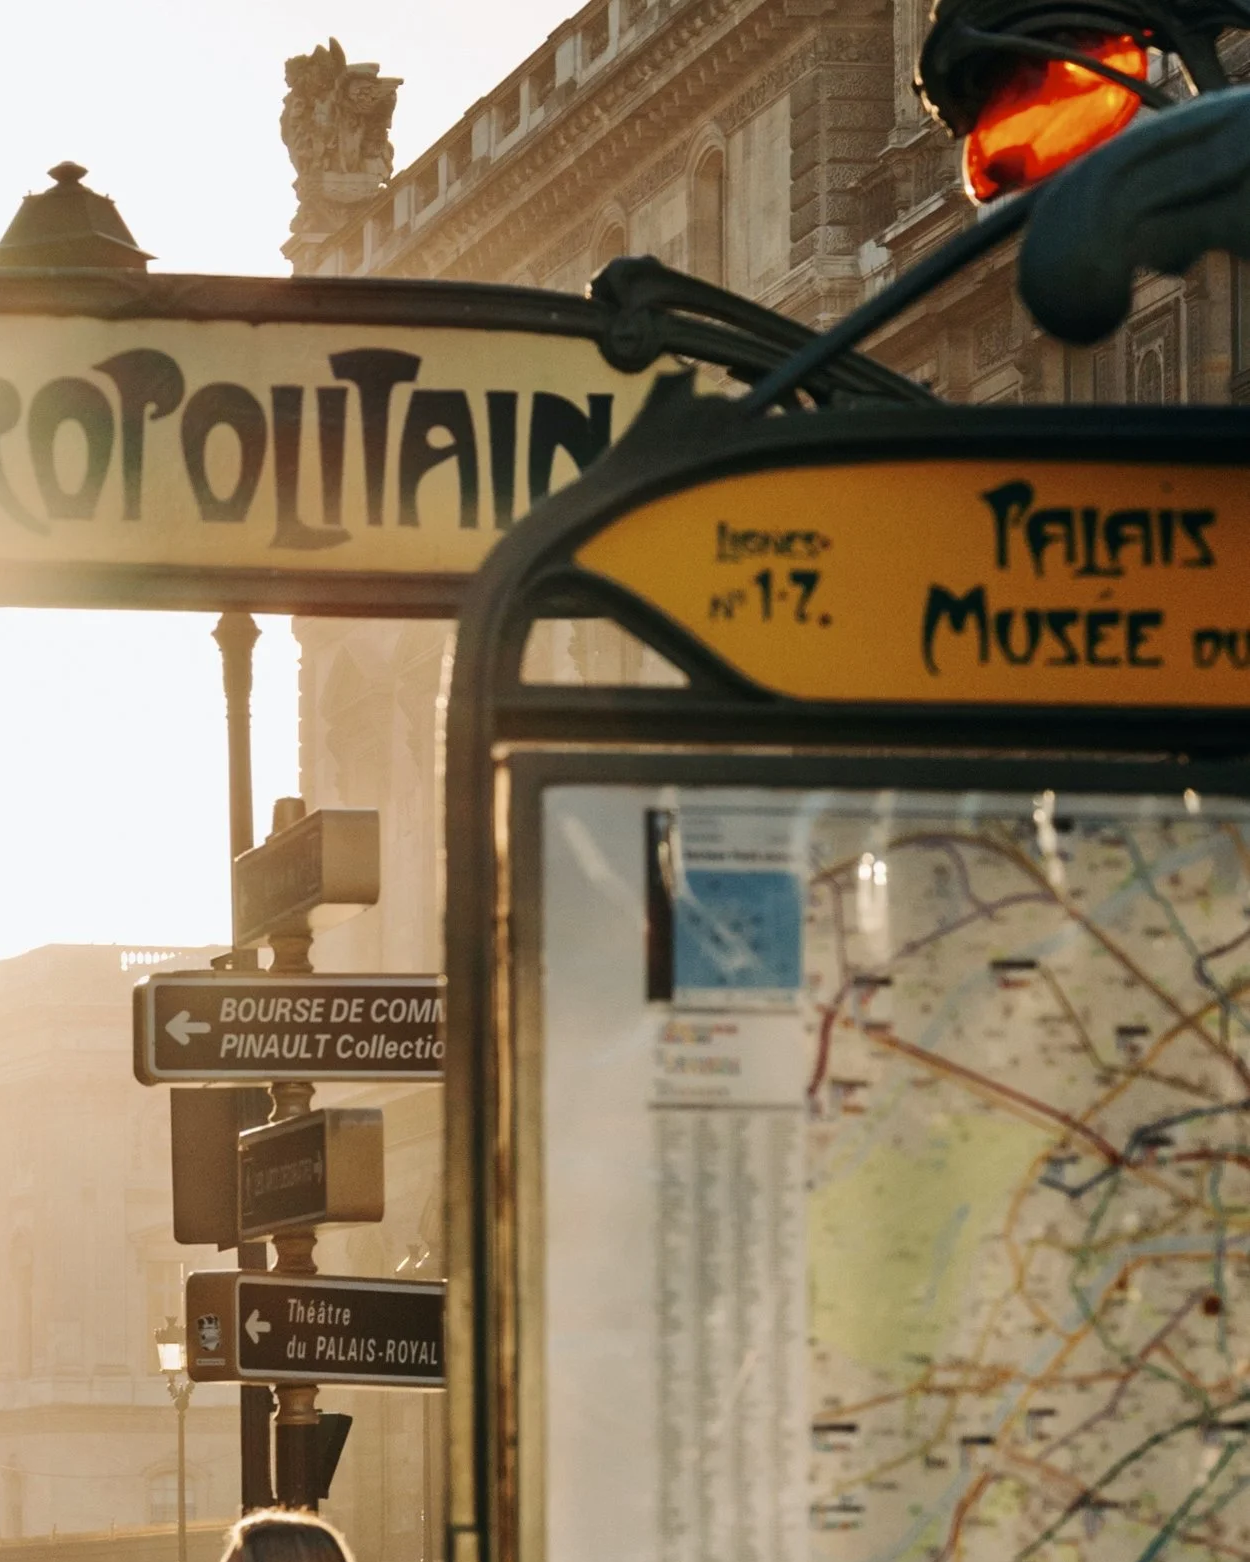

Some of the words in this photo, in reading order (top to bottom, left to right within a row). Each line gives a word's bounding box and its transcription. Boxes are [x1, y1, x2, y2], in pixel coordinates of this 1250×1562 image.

[981, 478, 1217, 578] PALAIS
[921, 581, 1166, 678] MUSÉE
[219, 997, 326, 1023] BOURSE
[330, 998, 365, 1023] DE
[219, 1034, 332, 1059] PINAULT
[287, 1298, 352, 1327] Théâtre
[286, 1335, 307, 1359] du
[315, 1336, 438, 1365] PALAIS-ROYAL
